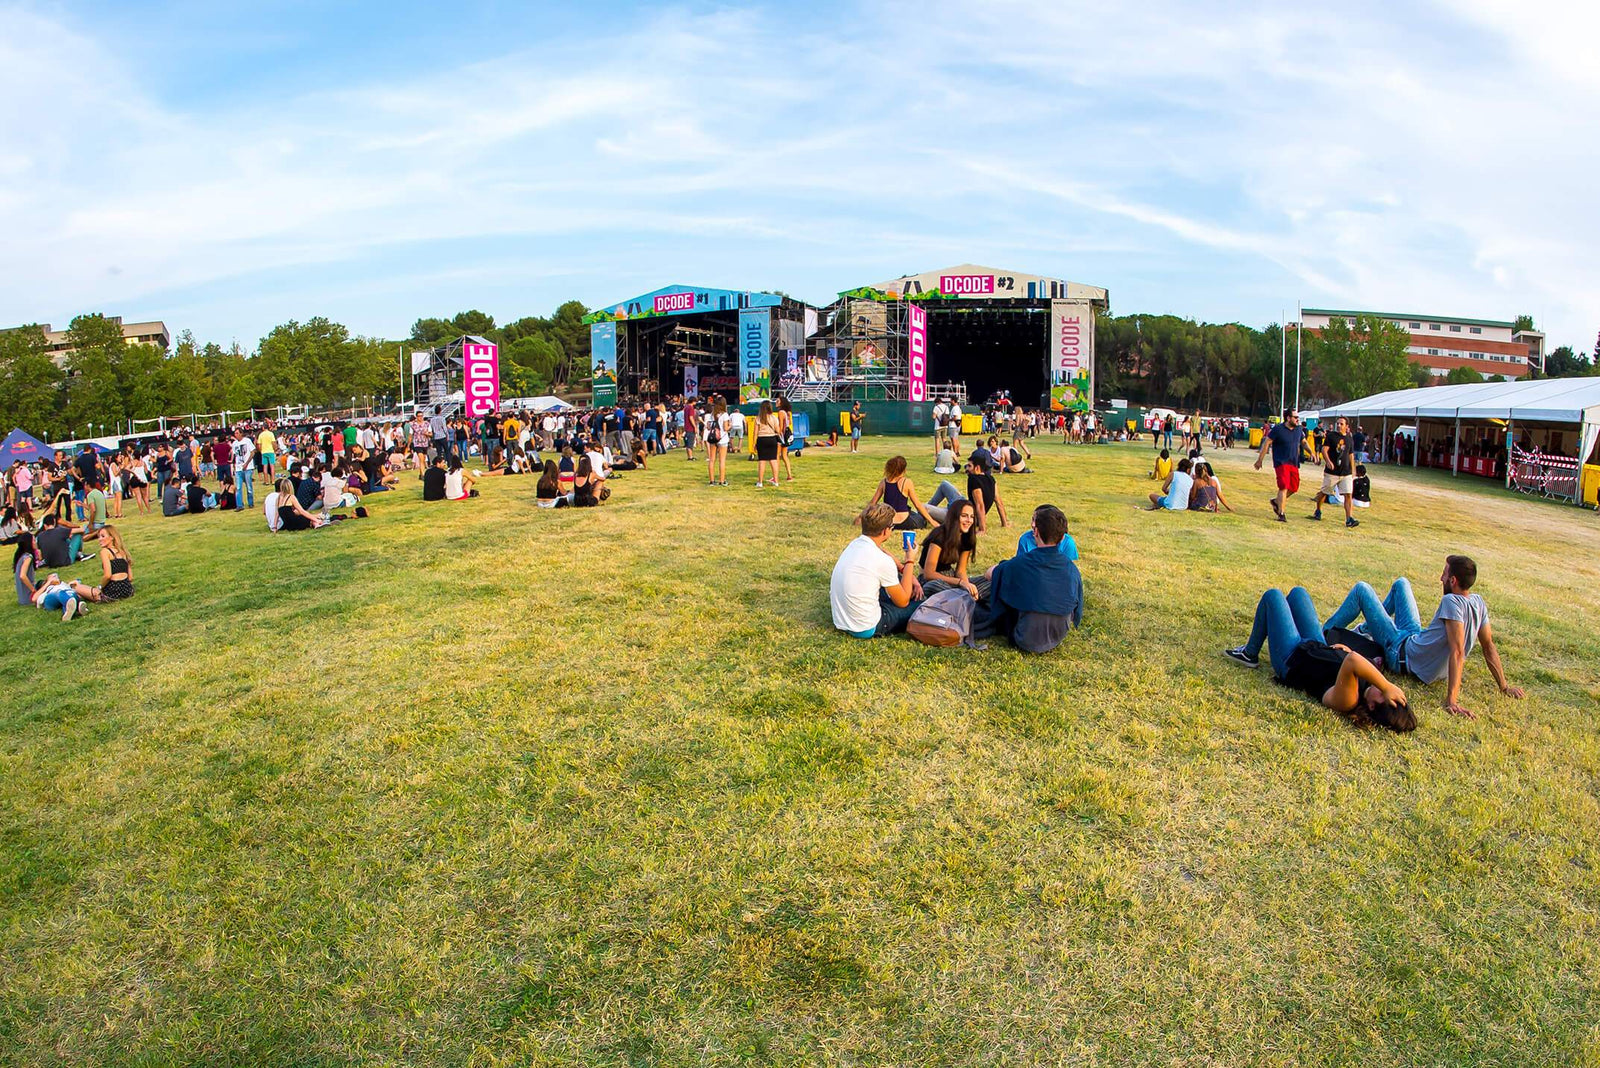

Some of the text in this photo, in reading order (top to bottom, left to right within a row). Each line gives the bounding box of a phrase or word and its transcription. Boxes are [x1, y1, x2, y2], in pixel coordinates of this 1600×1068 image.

[944, 276, 1015, 293] DCODE #2
[657, 293, 709, 311] DCODE #1
[746, 322, 762, 369] DCODE
[1061, 315, 1080, 368] DCODE
